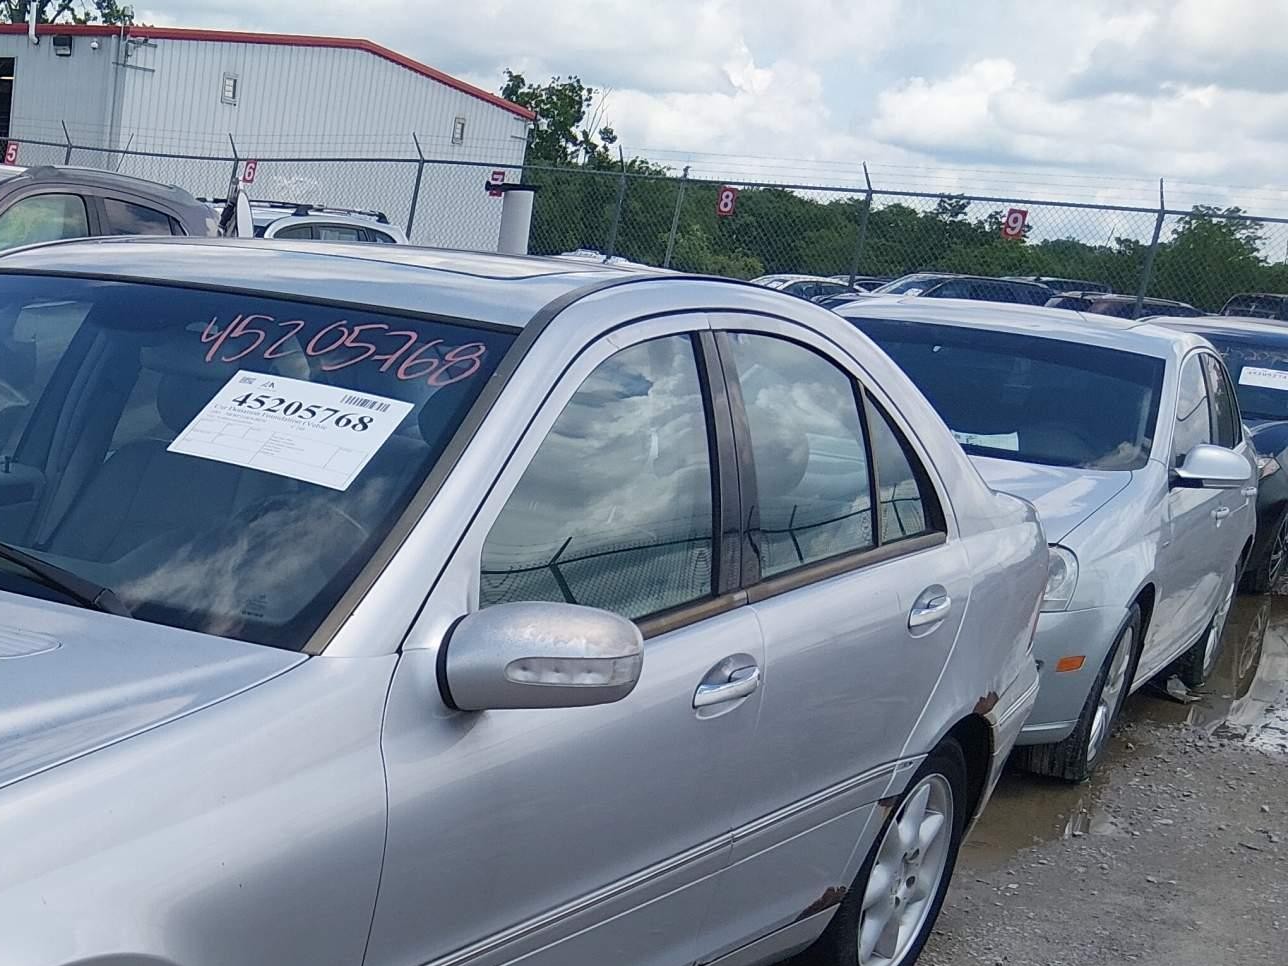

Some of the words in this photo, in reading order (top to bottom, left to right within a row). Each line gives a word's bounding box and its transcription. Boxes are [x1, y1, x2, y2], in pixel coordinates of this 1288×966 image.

[7, 144, 17, 162] 5
[245, 163, 255, 180] 6
[720, 191, 733, 212] 8
[1006, 212, 1023, 235] 9
[200, 314, 487, 387] 45205768
[232, 392, 375, 432] 45205768
